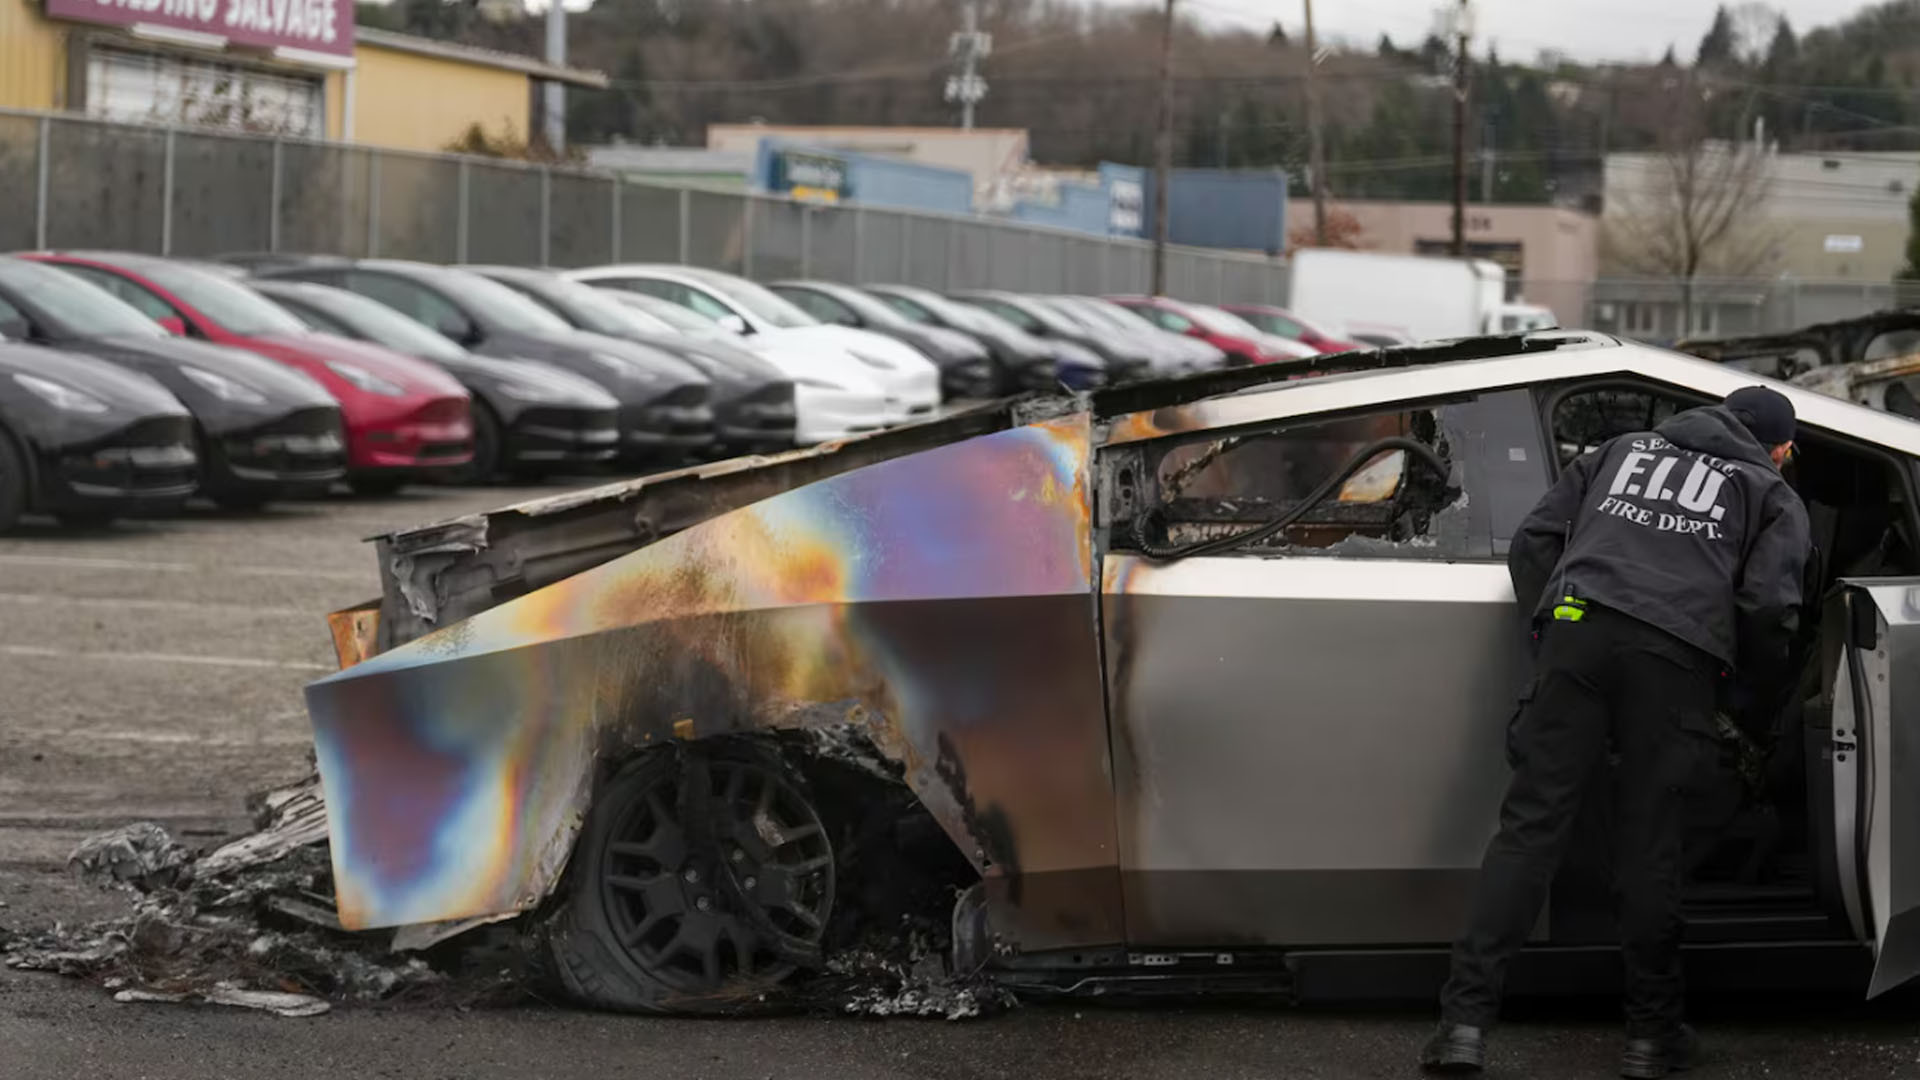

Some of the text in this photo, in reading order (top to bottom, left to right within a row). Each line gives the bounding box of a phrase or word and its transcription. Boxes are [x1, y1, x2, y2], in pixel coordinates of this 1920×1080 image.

[1631, 438, 1740, 477] SEALE
[1608, 452, 1726, 521] F.I.U.
[1597, 497, 1723, 539] FIRE DEPT.
